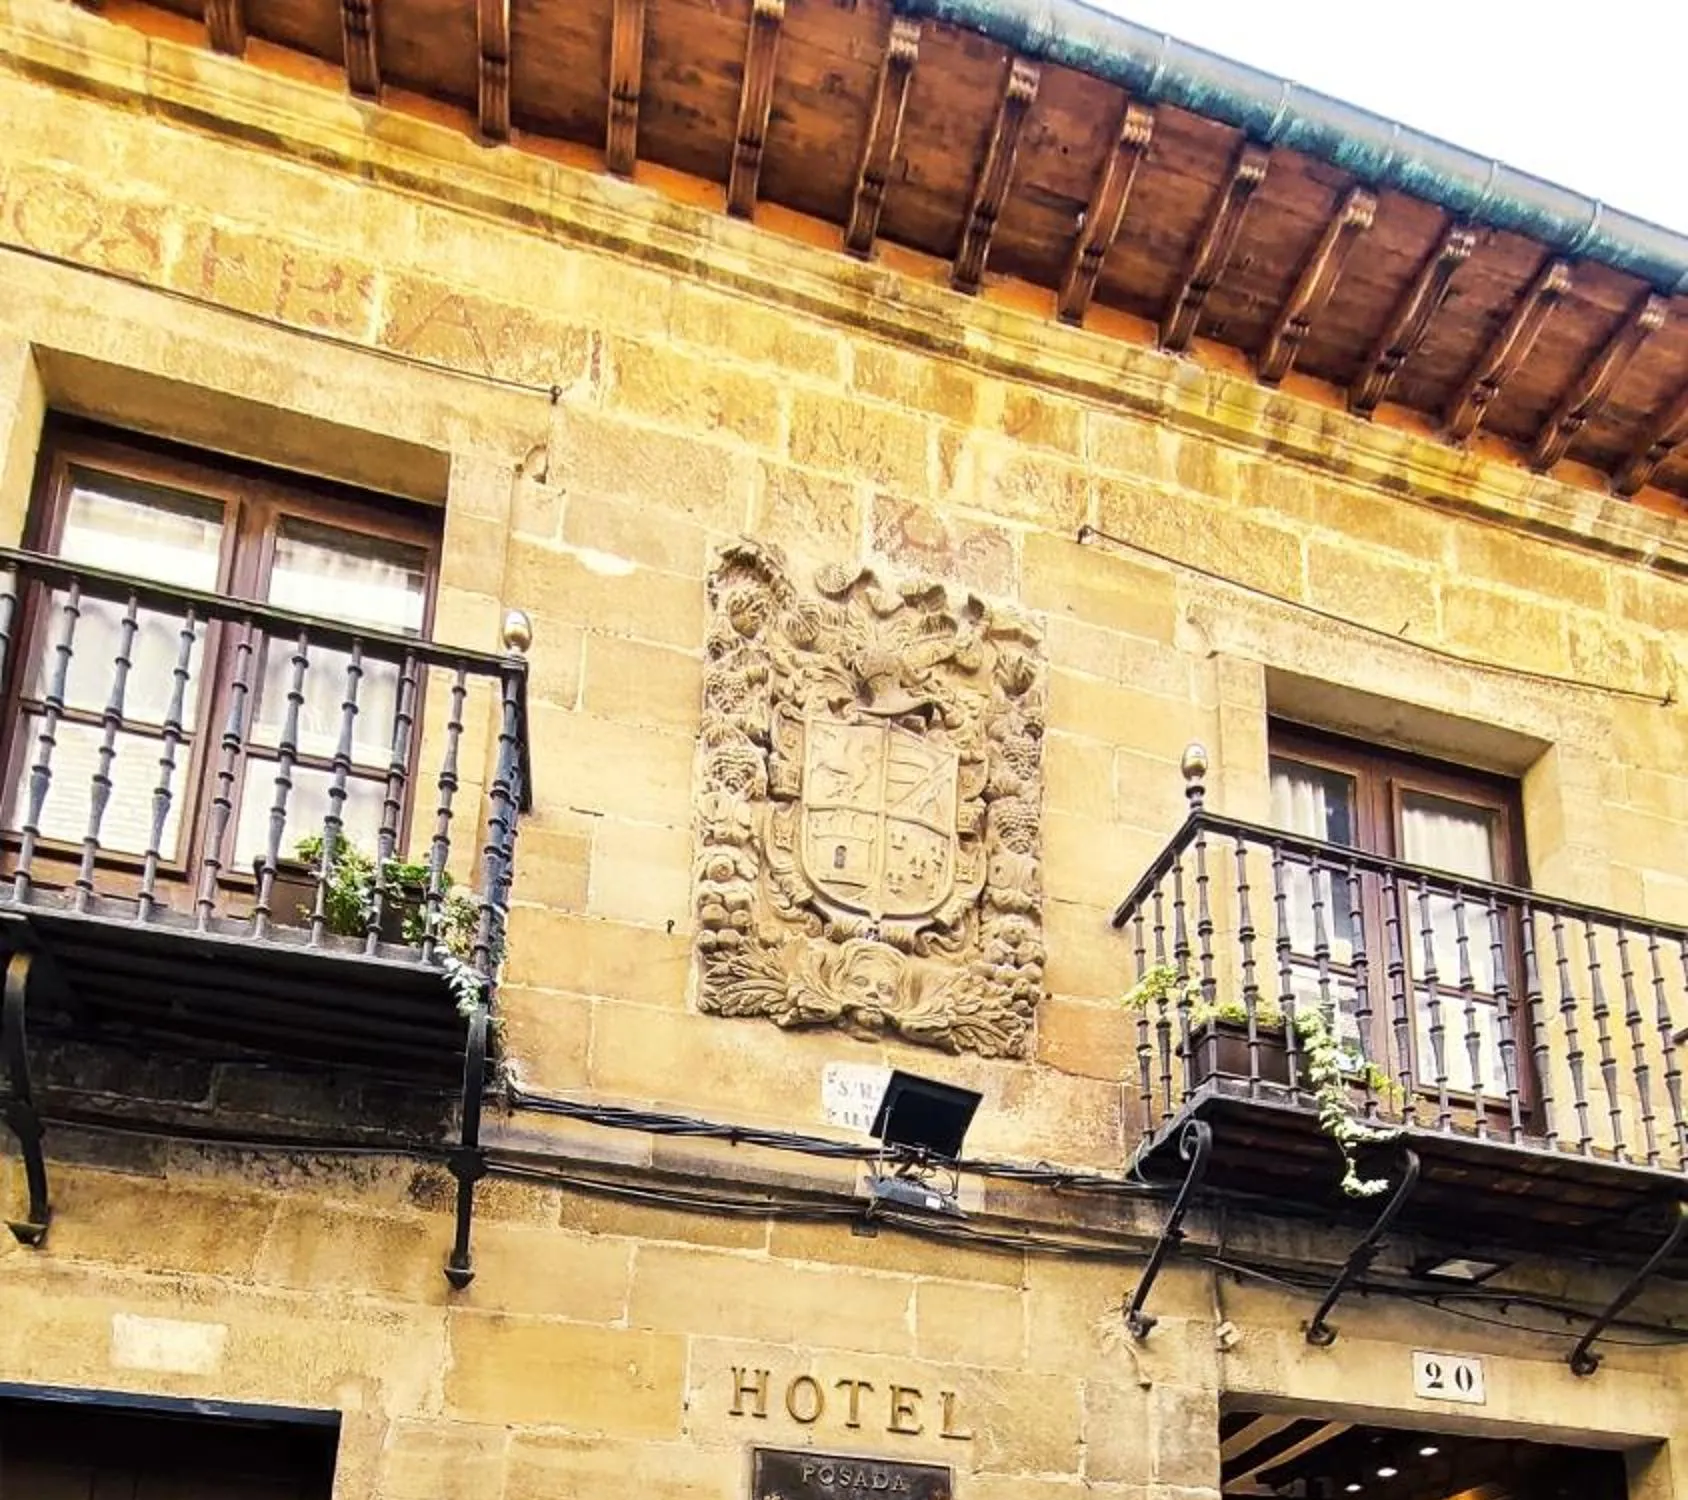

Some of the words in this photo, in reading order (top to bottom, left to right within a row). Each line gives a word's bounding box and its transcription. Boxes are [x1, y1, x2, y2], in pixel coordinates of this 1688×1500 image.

[1425, 1362, 1473, 1392] 20
[728, 1365, 973, 1438] HOTEL
[801, 1463, 911, 1492] POSADA
